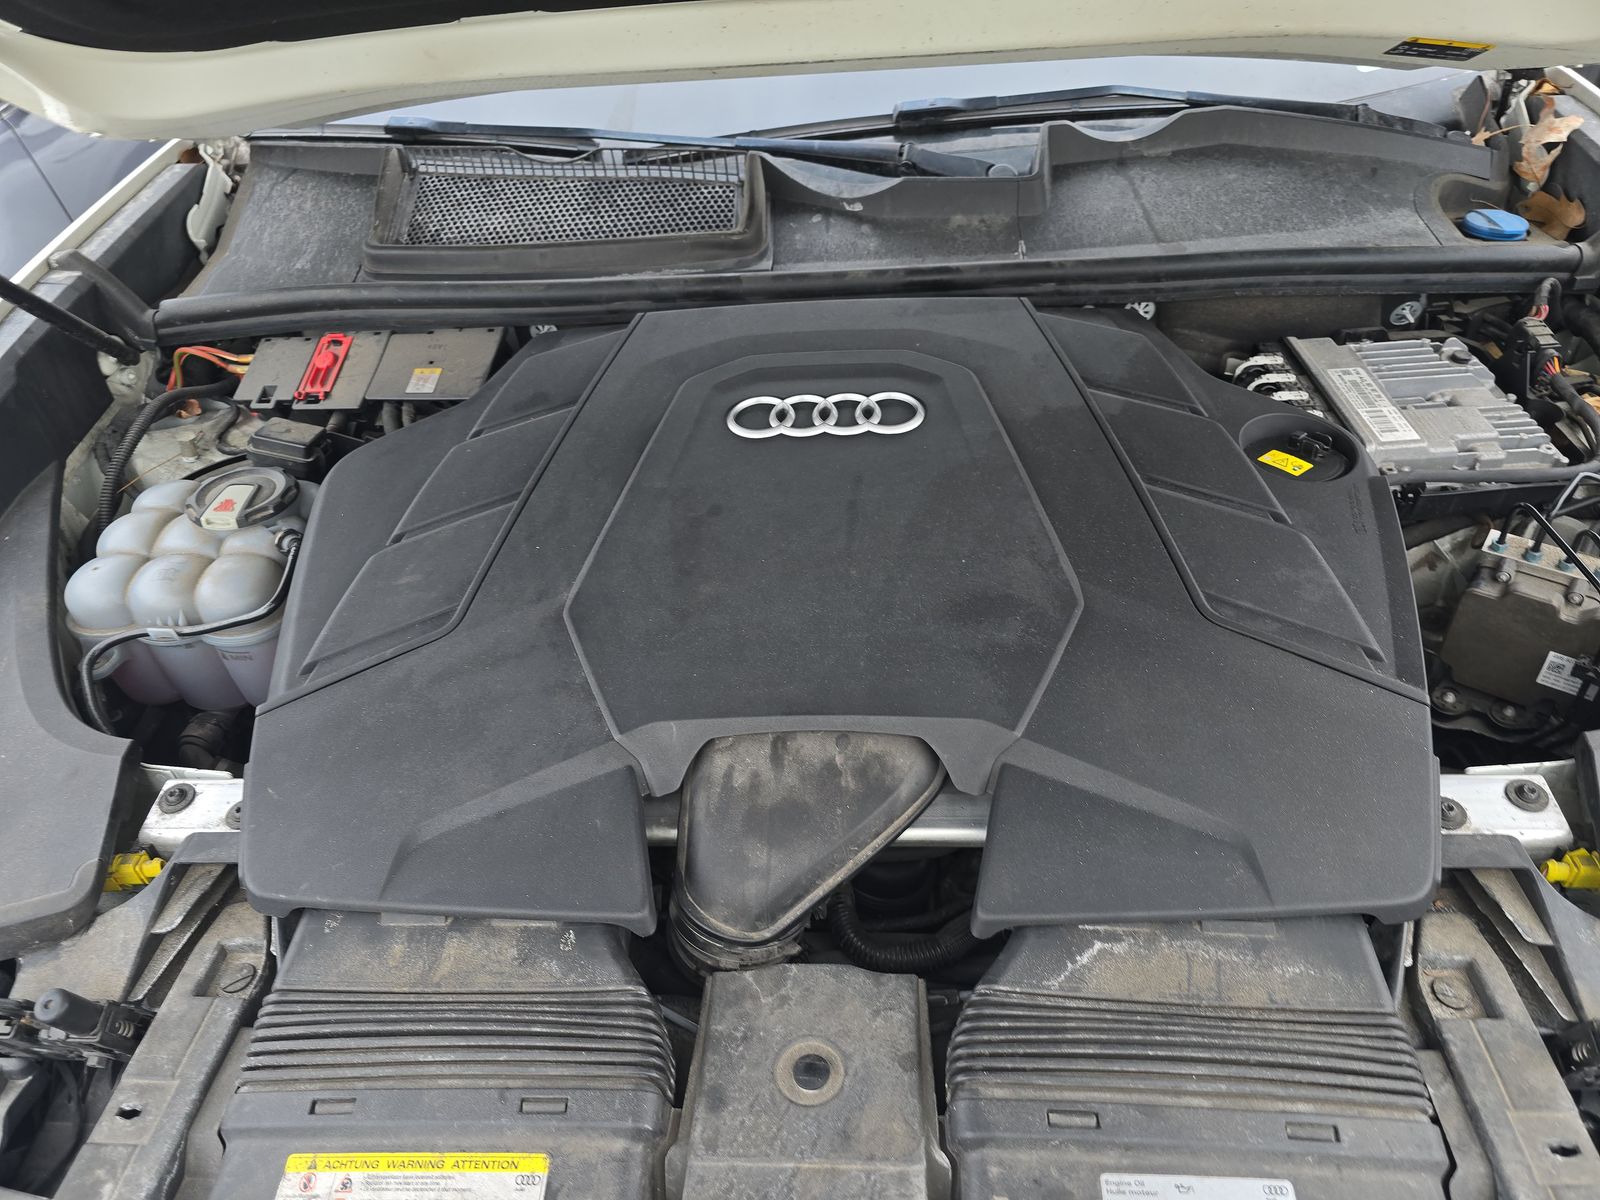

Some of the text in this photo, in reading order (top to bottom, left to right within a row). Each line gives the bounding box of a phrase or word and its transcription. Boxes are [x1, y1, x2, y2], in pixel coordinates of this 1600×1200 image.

[324, 1160, 520, 1170] ACHTUNG WARNING ATTENTION
